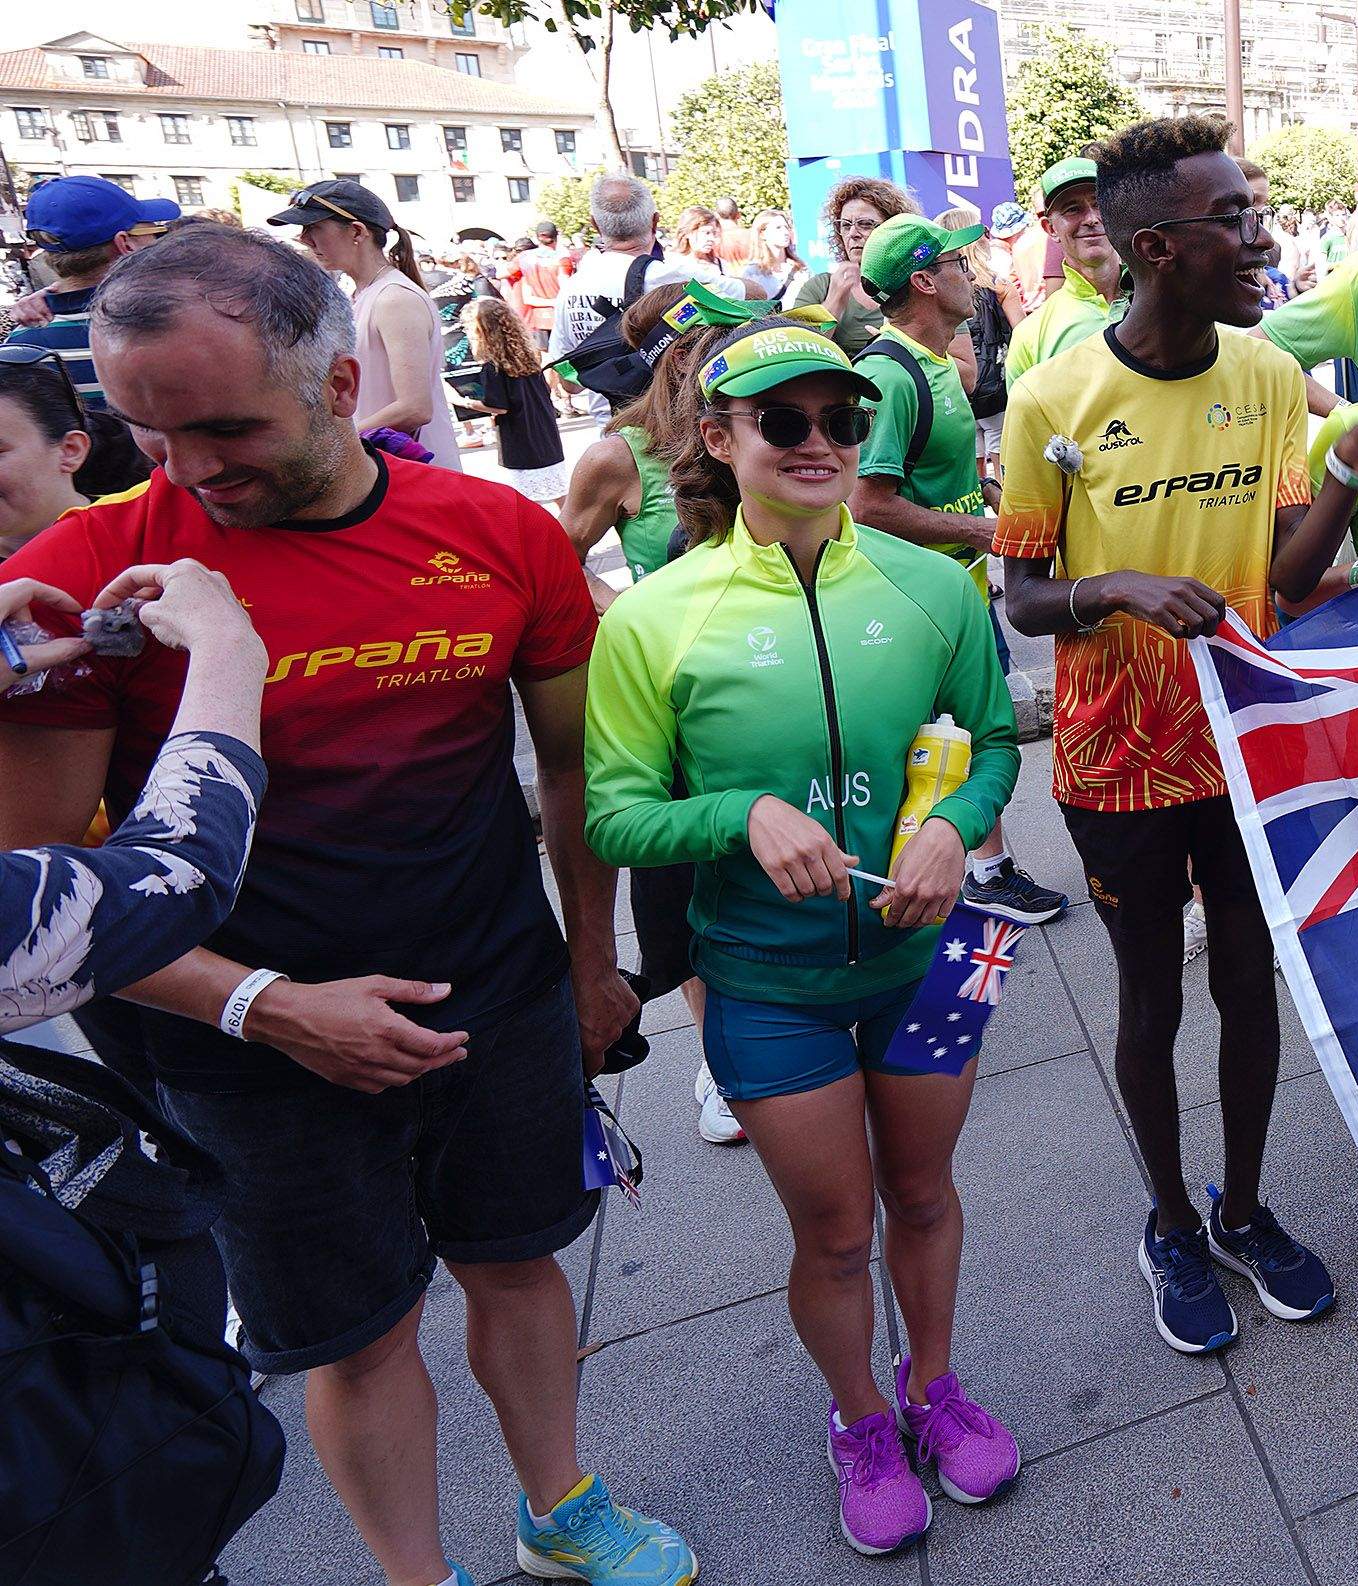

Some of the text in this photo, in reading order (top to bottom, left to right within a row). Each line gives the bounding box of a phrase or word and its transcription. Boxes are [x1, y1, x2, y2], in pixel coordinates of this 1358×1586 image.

[753, 331, 788, 349] AUS
[1198, 490, 1257, 510] TRIATLÓN
[859, 636, 894, 646] SCODY
[748, 658, 785, 669] Triathlon
[753, 651, 778, 661] World
[376, 664, 486, 690] TRIATLÓN
[806, 771, 871, 814] AUS
[228, 996, 250, 1028] 1079
